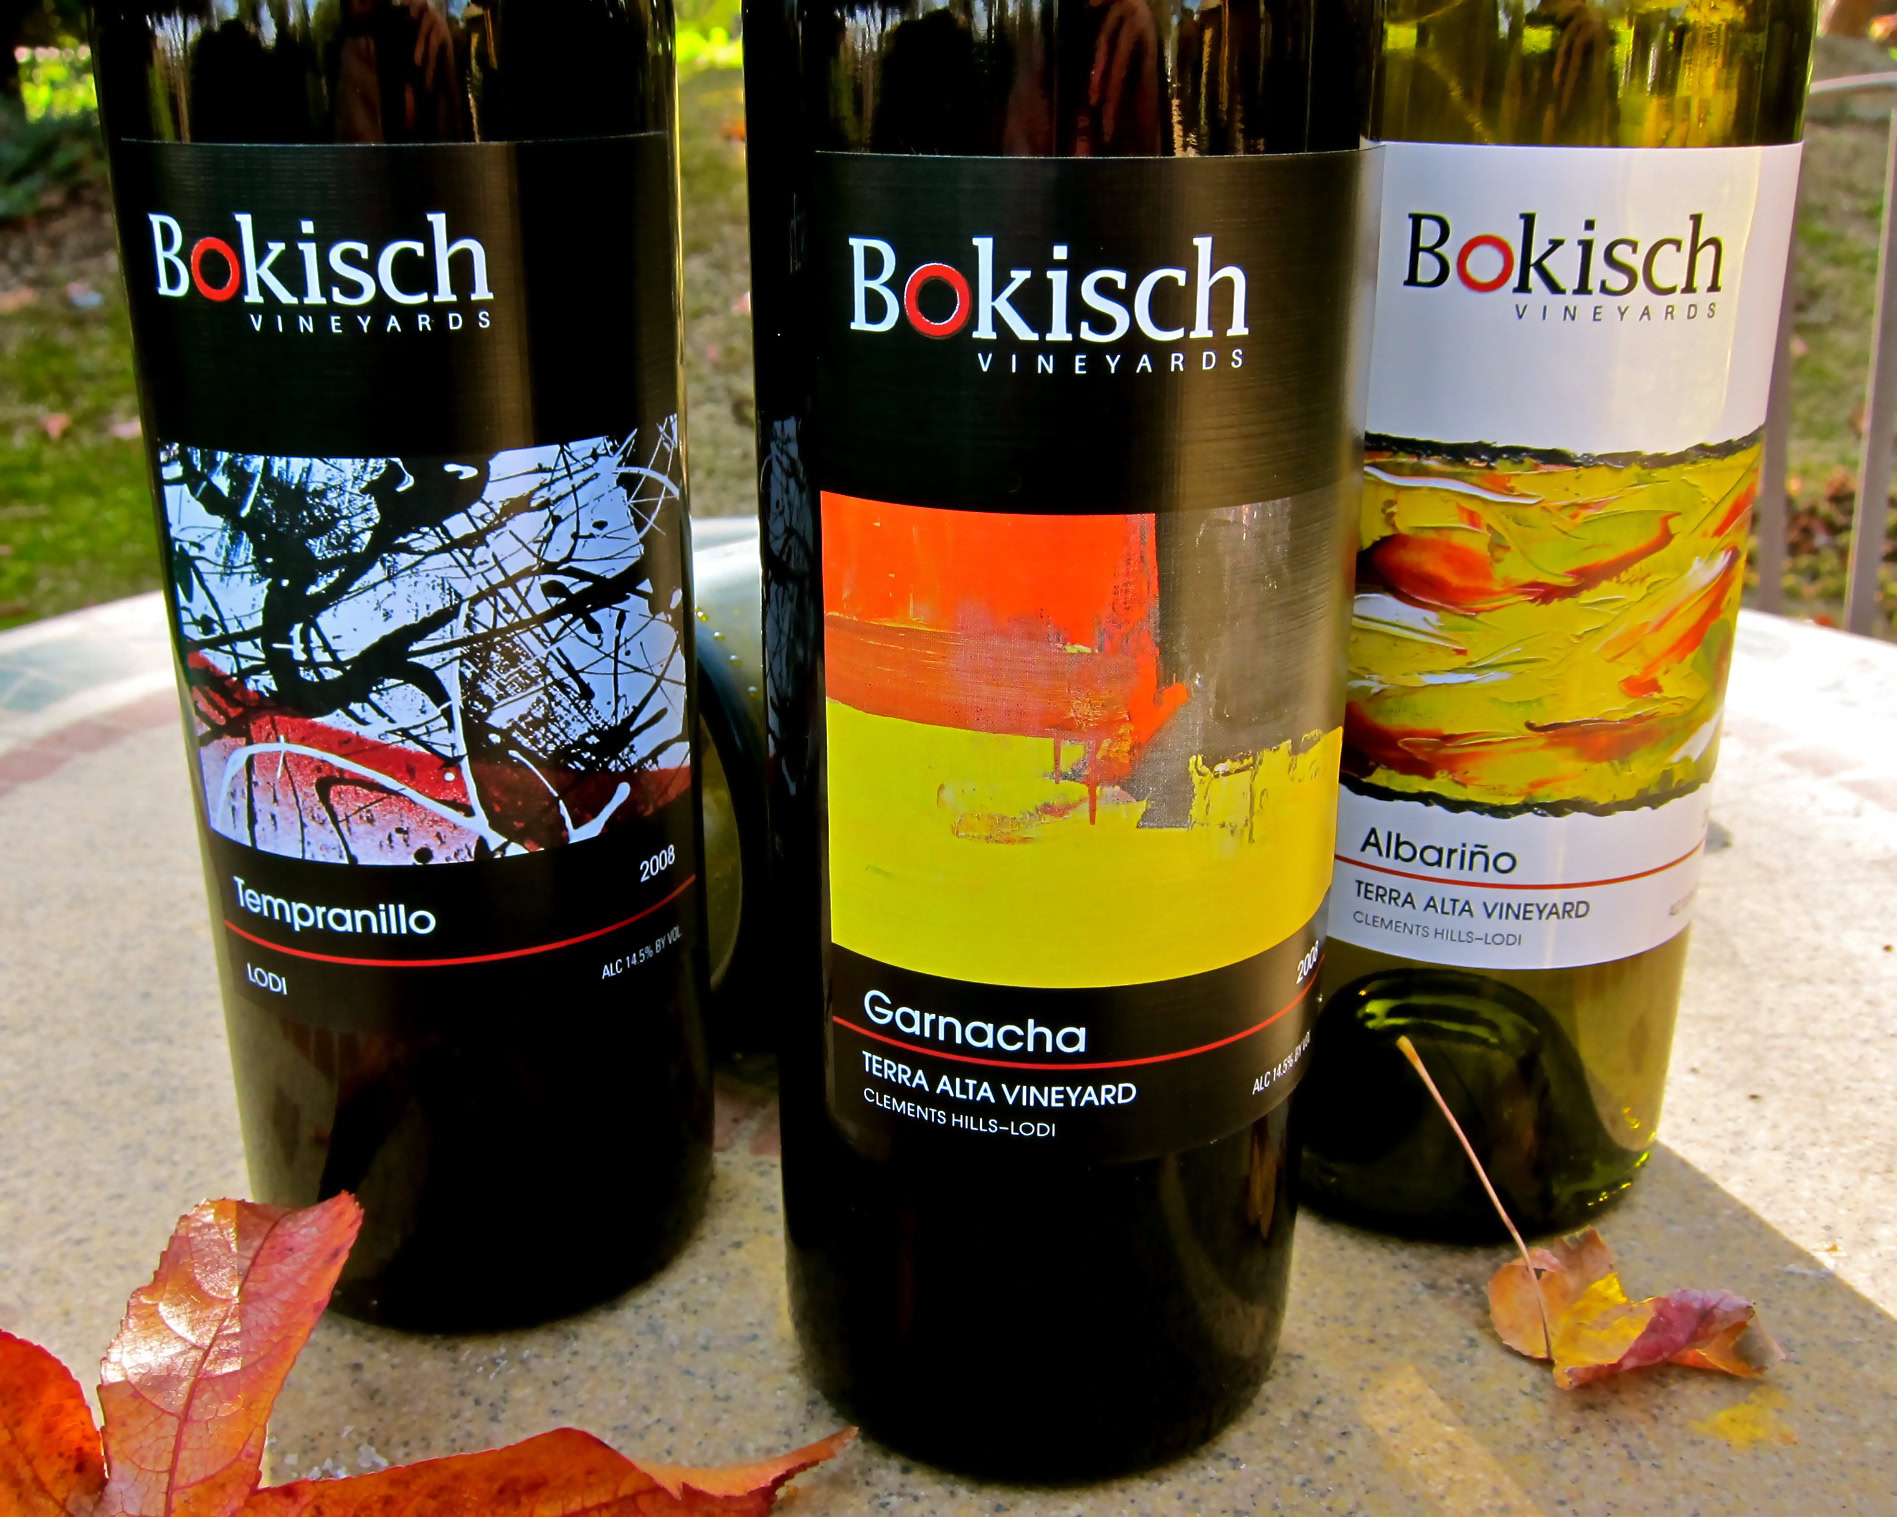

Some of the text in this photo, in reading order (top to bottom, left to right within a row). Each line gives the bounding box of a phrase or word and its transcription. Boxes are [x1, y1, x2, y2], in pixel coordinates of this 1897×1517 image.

[148, 212, 494, 305] Bokisch
[1403, 212, 1724, 295] Bokisch
[848, 236, 1250, 342] Bokisch
[249, 311, 491, 333] VINEYARDS
[1515, 303, 1717, 321] VINEYARDS
[977, 349, 1244, 374] VINEYARDS
[639, 844, 676, 882] 2008
[1360, 827, 1518, 875] Albariño
[232, 875, 436, 936] Tempranillo
[1355, 879, 1590, 921] TERRA ALTA VINEYARD
[1353, 911, 1430, 938] CLEMENTS
[247, 961, 288, 995] LODI
[602, 958, 623, 980] ALC
[626, 946, 654, 969] 14.5%
[655, 936, 666, 954] BY
[863, 989, 1087, 1053] Garnacha
[862, 1050, 1137, 1107] TERRA ALTA VINEYARD
[1252, 1071, 1271, 1095] ALC
[863, 1087, 947, 1125] CLEMENTS
